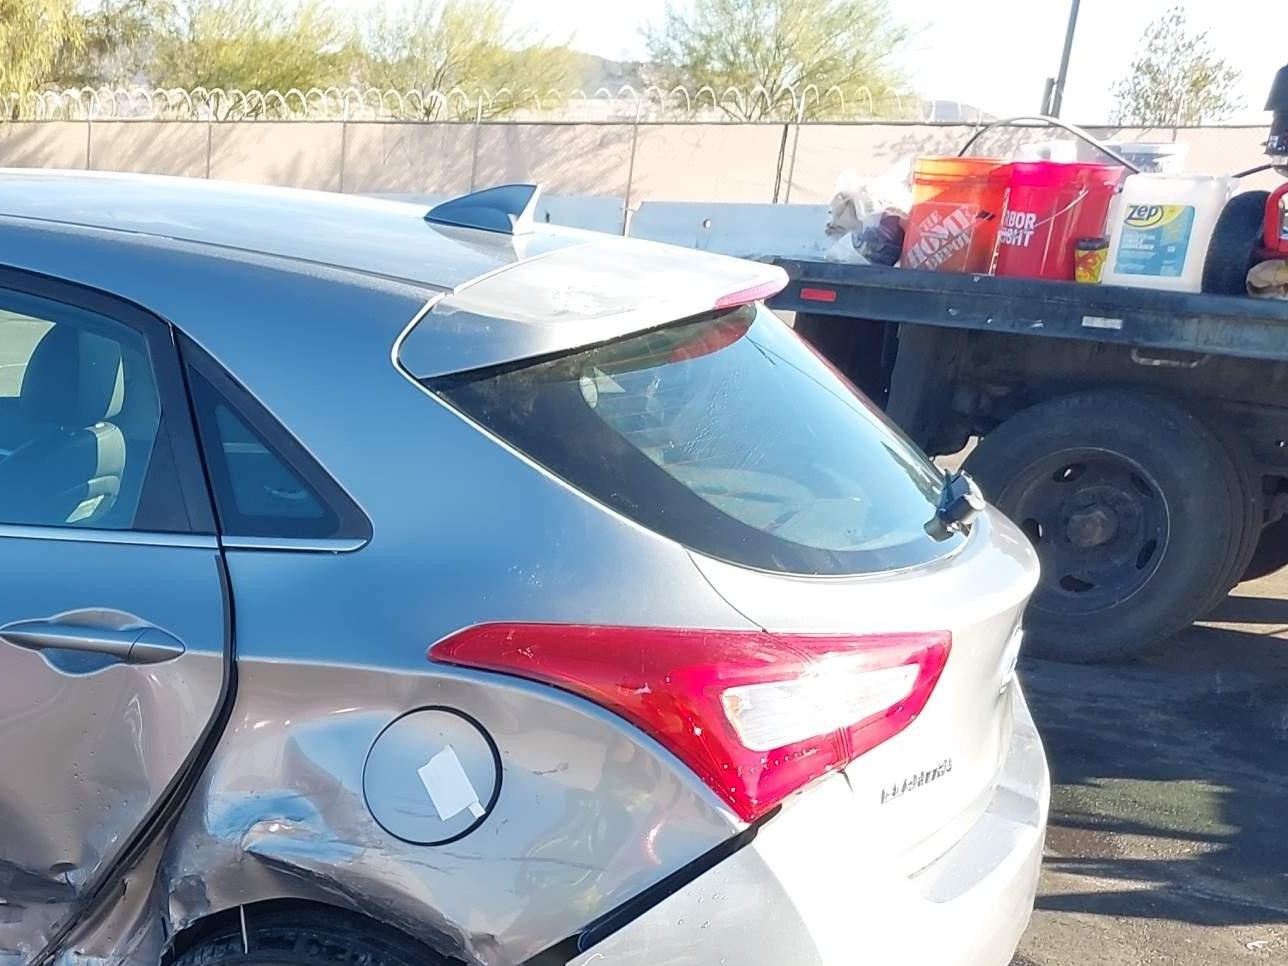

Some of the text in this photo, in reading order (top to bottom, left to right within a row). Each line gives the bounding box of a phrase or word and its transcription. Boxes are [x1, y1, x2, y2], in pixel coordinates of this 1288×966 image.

[906, 203, 976, 270] HOME
[919, 209, 944, 232] THE
[924, 229, 972, 271] DEPOT
